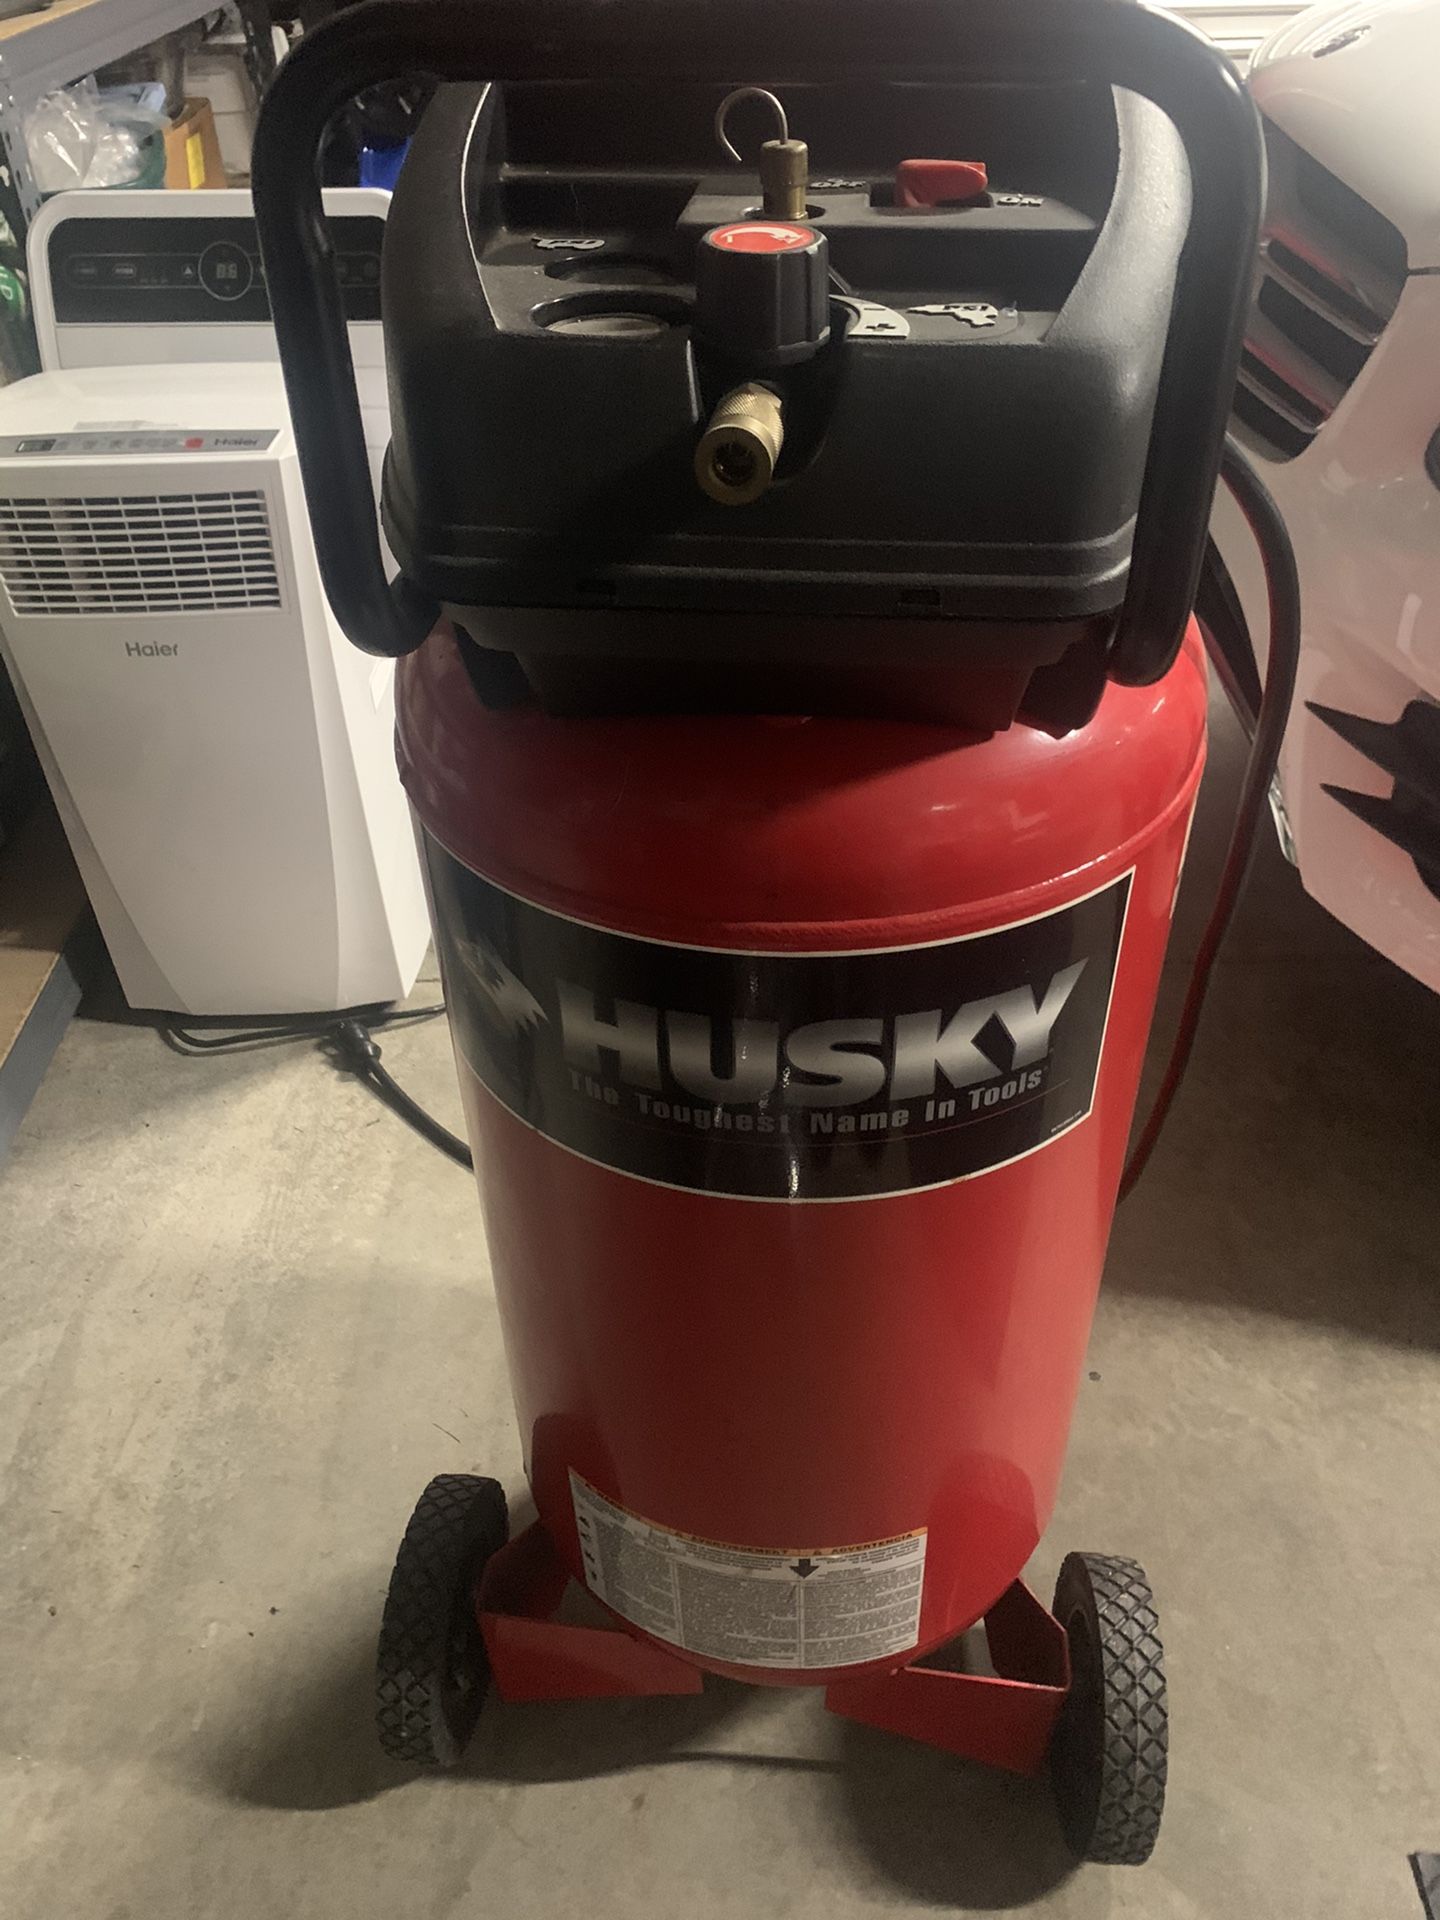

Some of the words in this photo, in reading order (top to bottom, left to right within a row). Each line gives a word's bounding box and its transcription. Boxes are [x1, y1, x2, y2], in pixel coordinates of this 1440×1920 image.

[997, 193, 1044, 206] ON
[213, 437, 259, 447] Haier
[125, 640, 179, 657] Haier
[555, 956, 1089, 1107] HUSKY
[568, 1067, 620, 1105] The
[634, 1092, 791, 1135] Toughest
[810, 1108, 910, 1135] Name
[924, 1099, 956, 1123] In
[968, 1067, 1042, 1112] Tools
